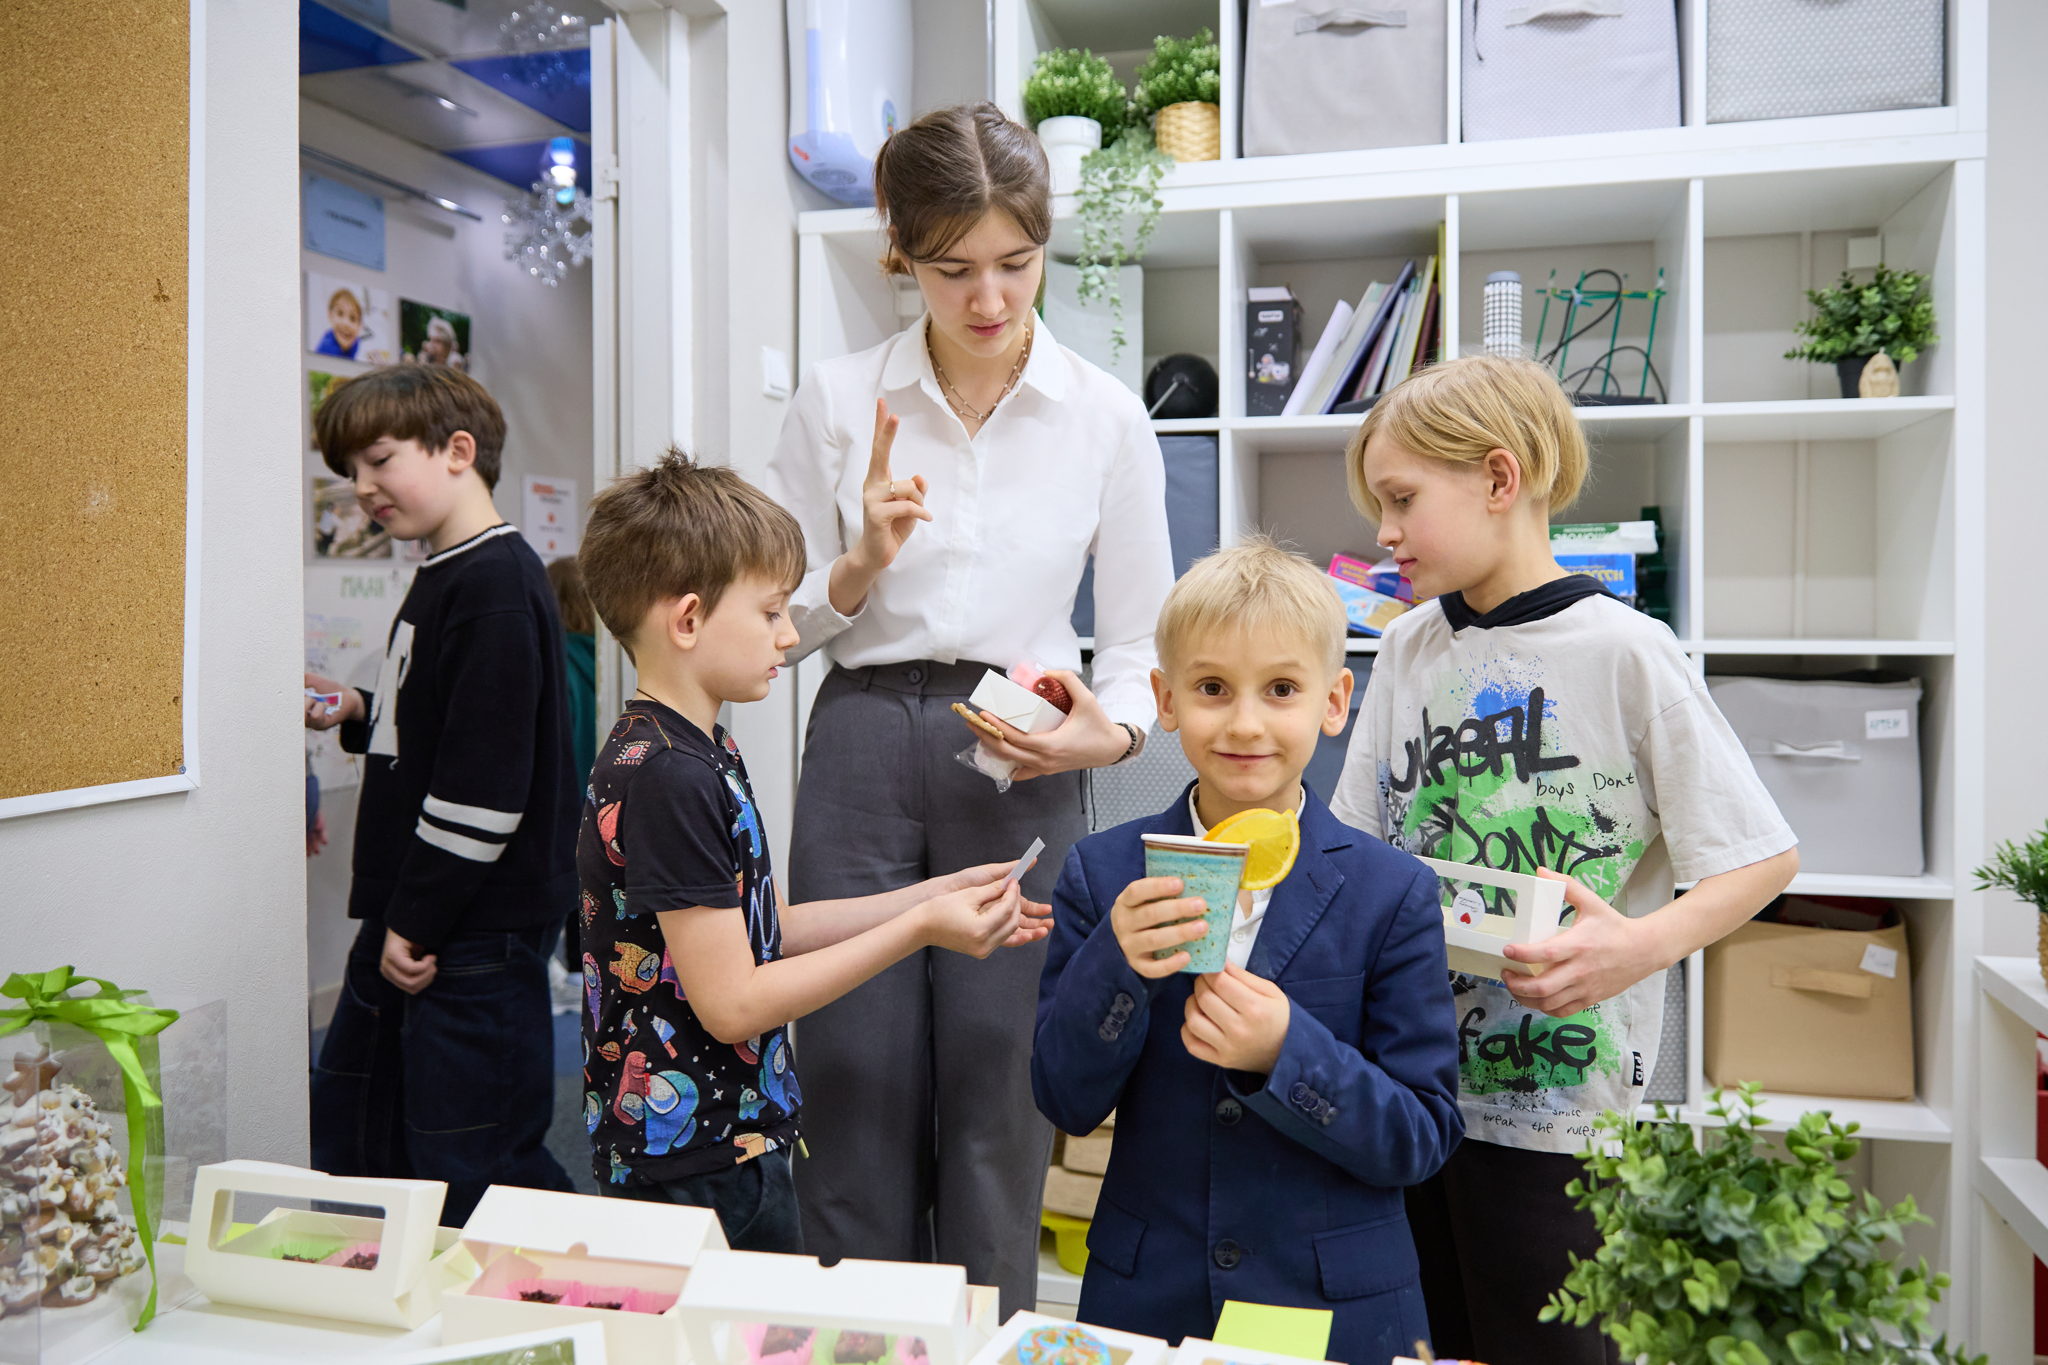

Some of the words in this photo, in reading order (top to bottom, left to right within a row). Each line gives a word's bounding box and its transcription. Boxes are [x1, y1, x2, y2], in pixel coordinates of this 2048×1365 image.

[1458, 1007, 1597, 1070] fake
[1483, 1112, 1517, 1128] break
[1531, 1121, 1554, 1134] the
